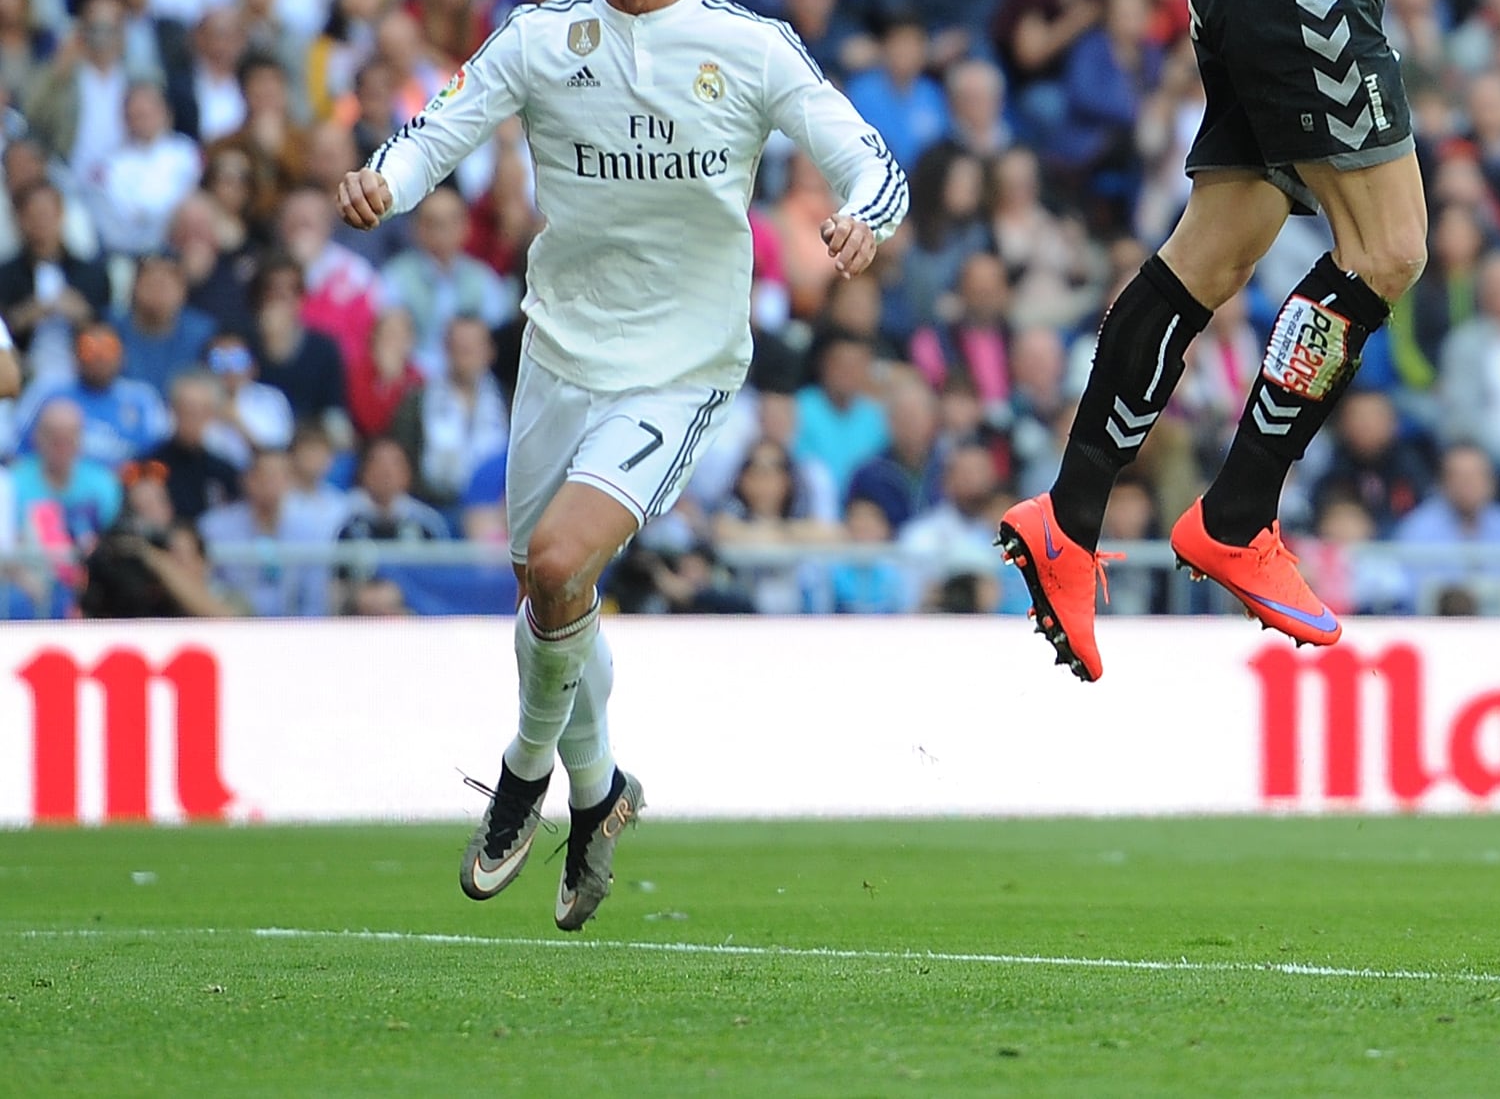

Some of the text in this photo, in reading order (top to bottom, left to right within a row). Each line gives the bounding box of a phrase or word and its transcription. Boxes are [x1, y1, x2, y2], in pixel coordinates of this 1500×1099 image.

[566, 79, 601, 87] adidas
[1364, 73, 1391, 132] hummel
[629, 115, 674, 144] Fly
[574, 142, 730, 179] Emirates
[618, 420, 664, 473] 7
